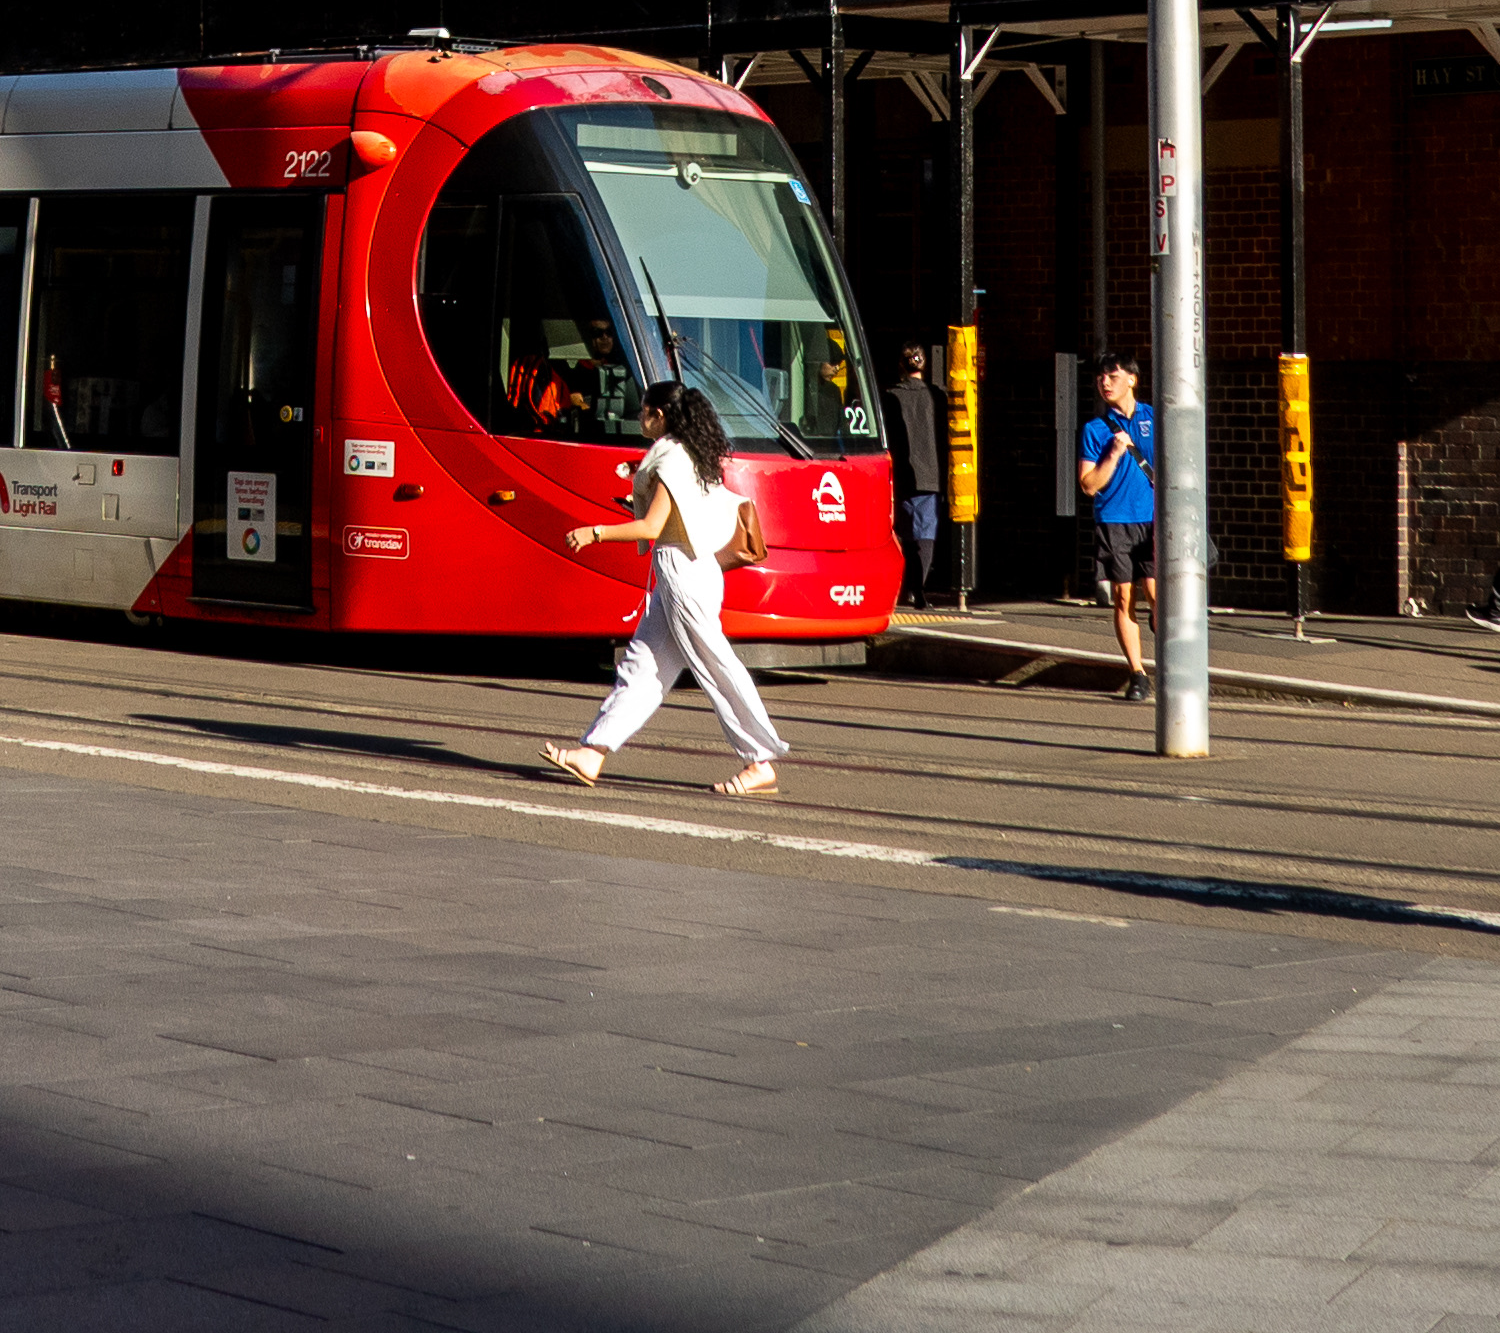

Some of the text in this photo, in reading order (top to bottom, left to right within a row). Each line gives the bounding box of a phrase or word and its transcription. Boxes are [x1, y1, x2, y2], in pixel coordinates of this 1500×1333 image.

[1416, 65, 1485, 85] HAY ST
[283, 150, 331, 178] 2122
[844, 407, 869, 434] 22
[12, 480, 58, 499] Transport
[249, 488, 268, 496] before
[253, 480, 269, 488] every
[13, 499, 57, 517] Light Rail
[238, 496, 265, 505] boarding
[364, 539, 402, 550] transdev
[829, 585, 865, 606] CAF
